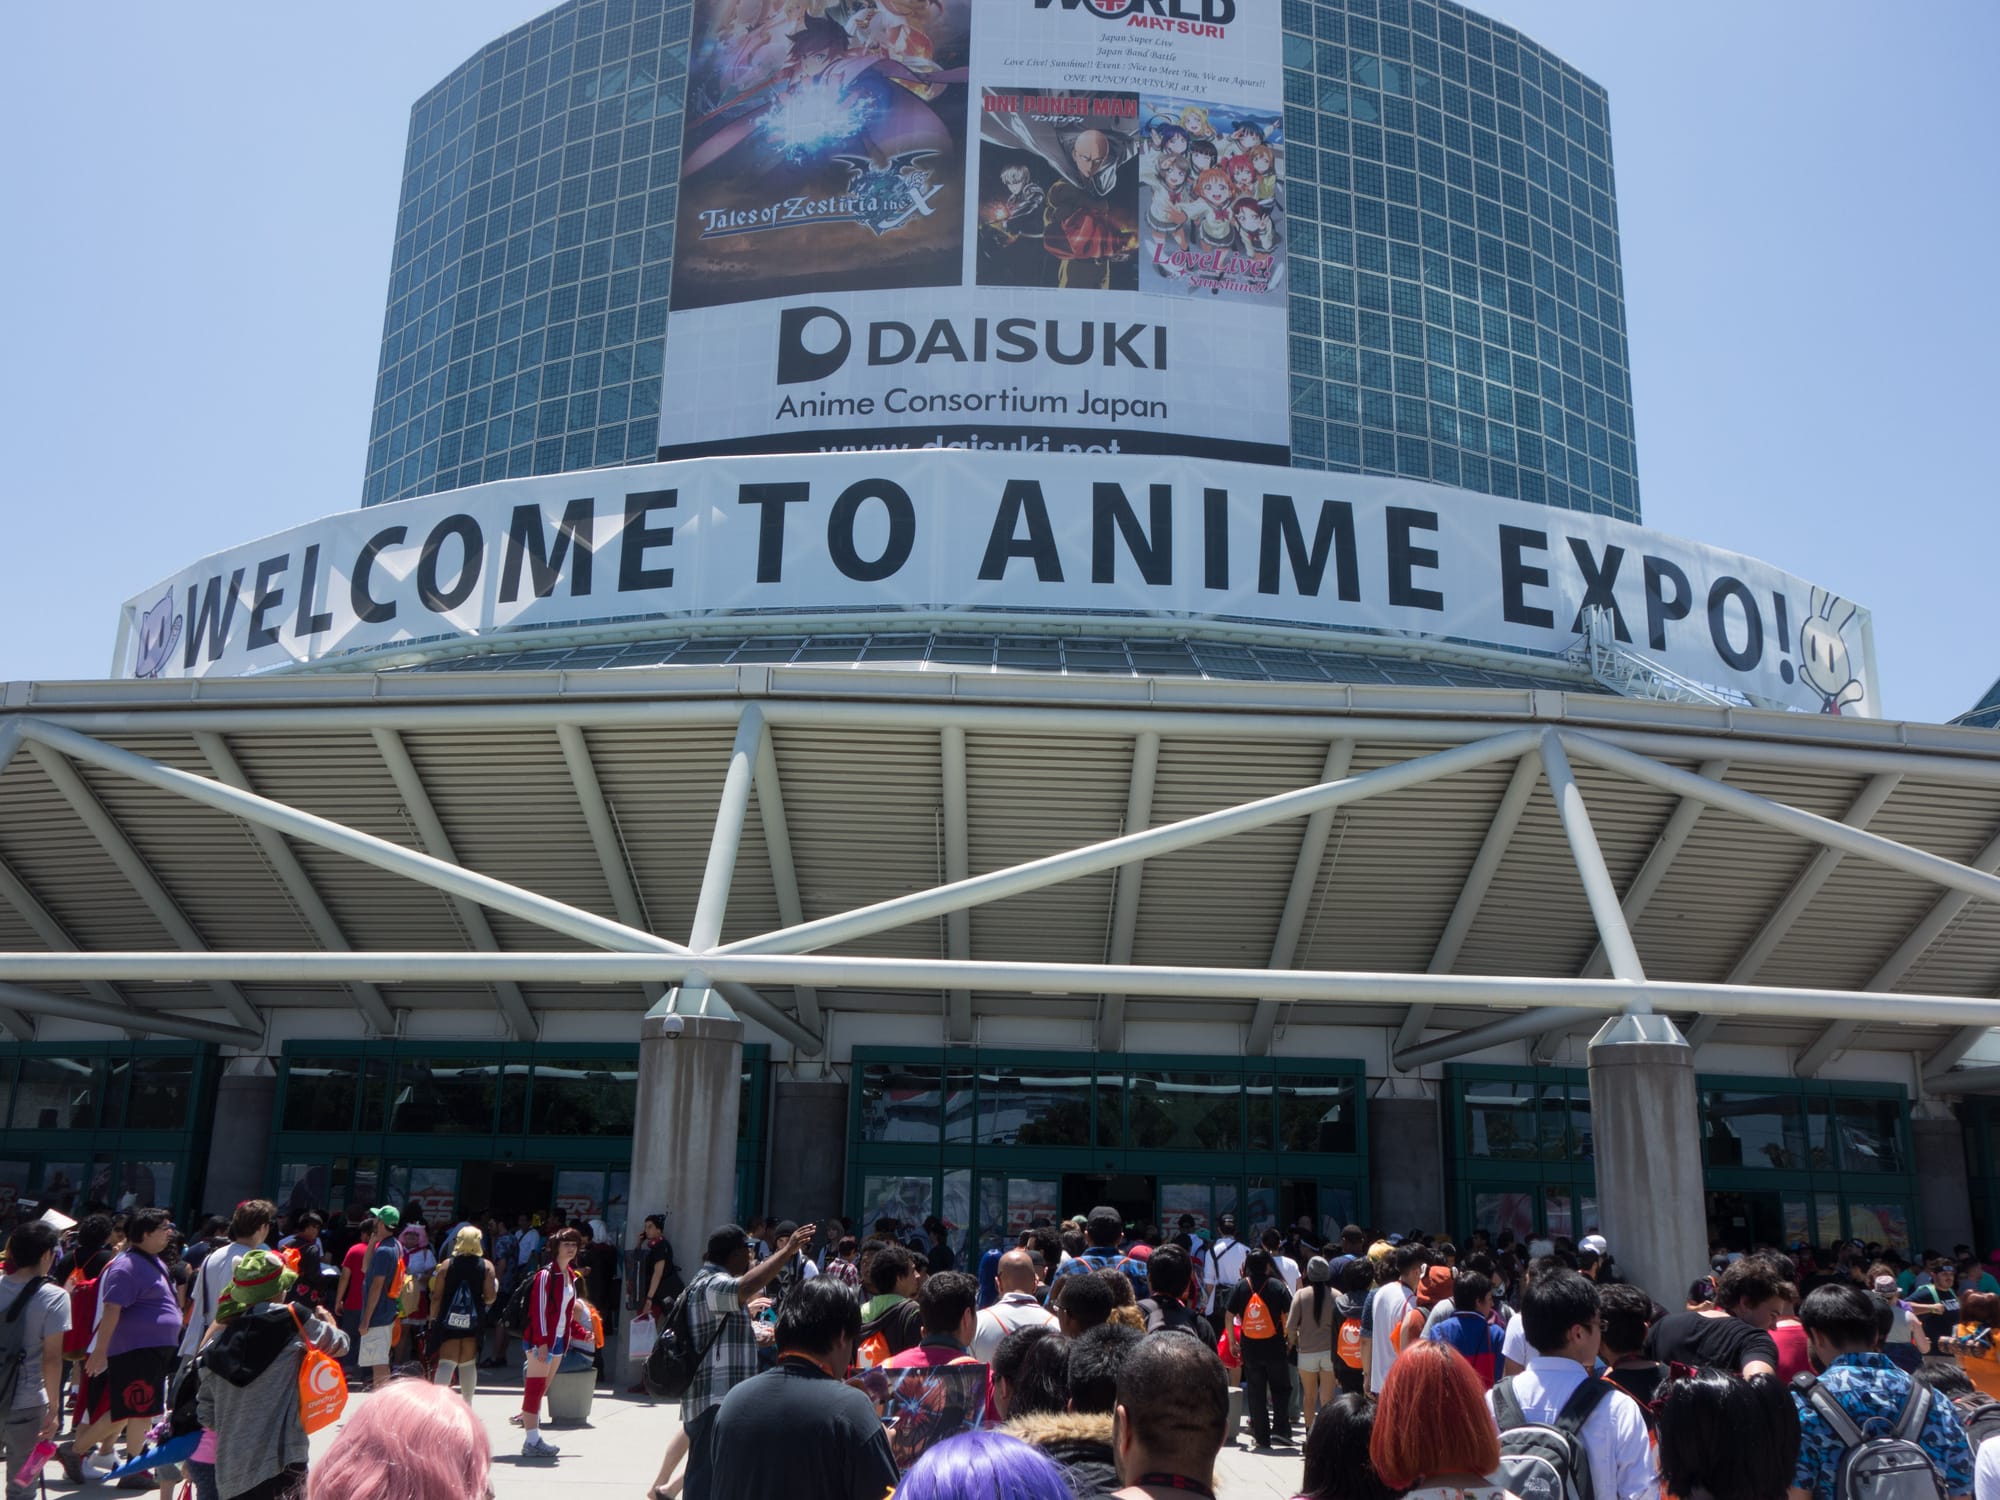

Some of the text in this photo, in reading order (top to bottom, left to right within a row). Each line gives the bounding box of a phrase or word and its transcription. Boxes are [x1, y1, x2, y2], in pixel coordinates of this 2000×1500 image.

[1034, 0, 1236, 25] RLD
[1126, 14, 1225, 40] MATSURI
[1099, 33, 1174, 47] Japan Super Live
[1096, 47, 1177, 62] Japan Band Battle
[1003, 58, 1024, 66] Love
[1026, 58, 1048, 67] Live!
[1050, 59, 1093, 69] Sunshine!!
[1096, 60, 1120, 69] Event
[1127, 62, 1147, 72] Nice
[1149, 64, 1158, 73] to
[1158, 66, 1180, 76] Meet
[1182, 67, 1200, 80] You,
[1201, 72, 1215, 81] We
[1217, 75, 1231, 84] are
[1063, 73, 1208, 94] ONE PUNCH MATSURI at AX
[984, 94, 1138, 119] ONE PUNCH MAN
[698, 207, 757, 232] Tales
[761, 202, 781, 228] of
[781, 195, 878, 220] Zestiria
[878, 184, 945, 229] X
[1188, 275, 1269, 294] Sunshine!!
[867, 317, 1168, 371] DAISUKI
[775, 386, 1168, 423] Anime Consortium Japan
[819, 434, 1121, 454] disukint
[183, 477, 1795, 685] WELCOME TO ANIME EXPO!
